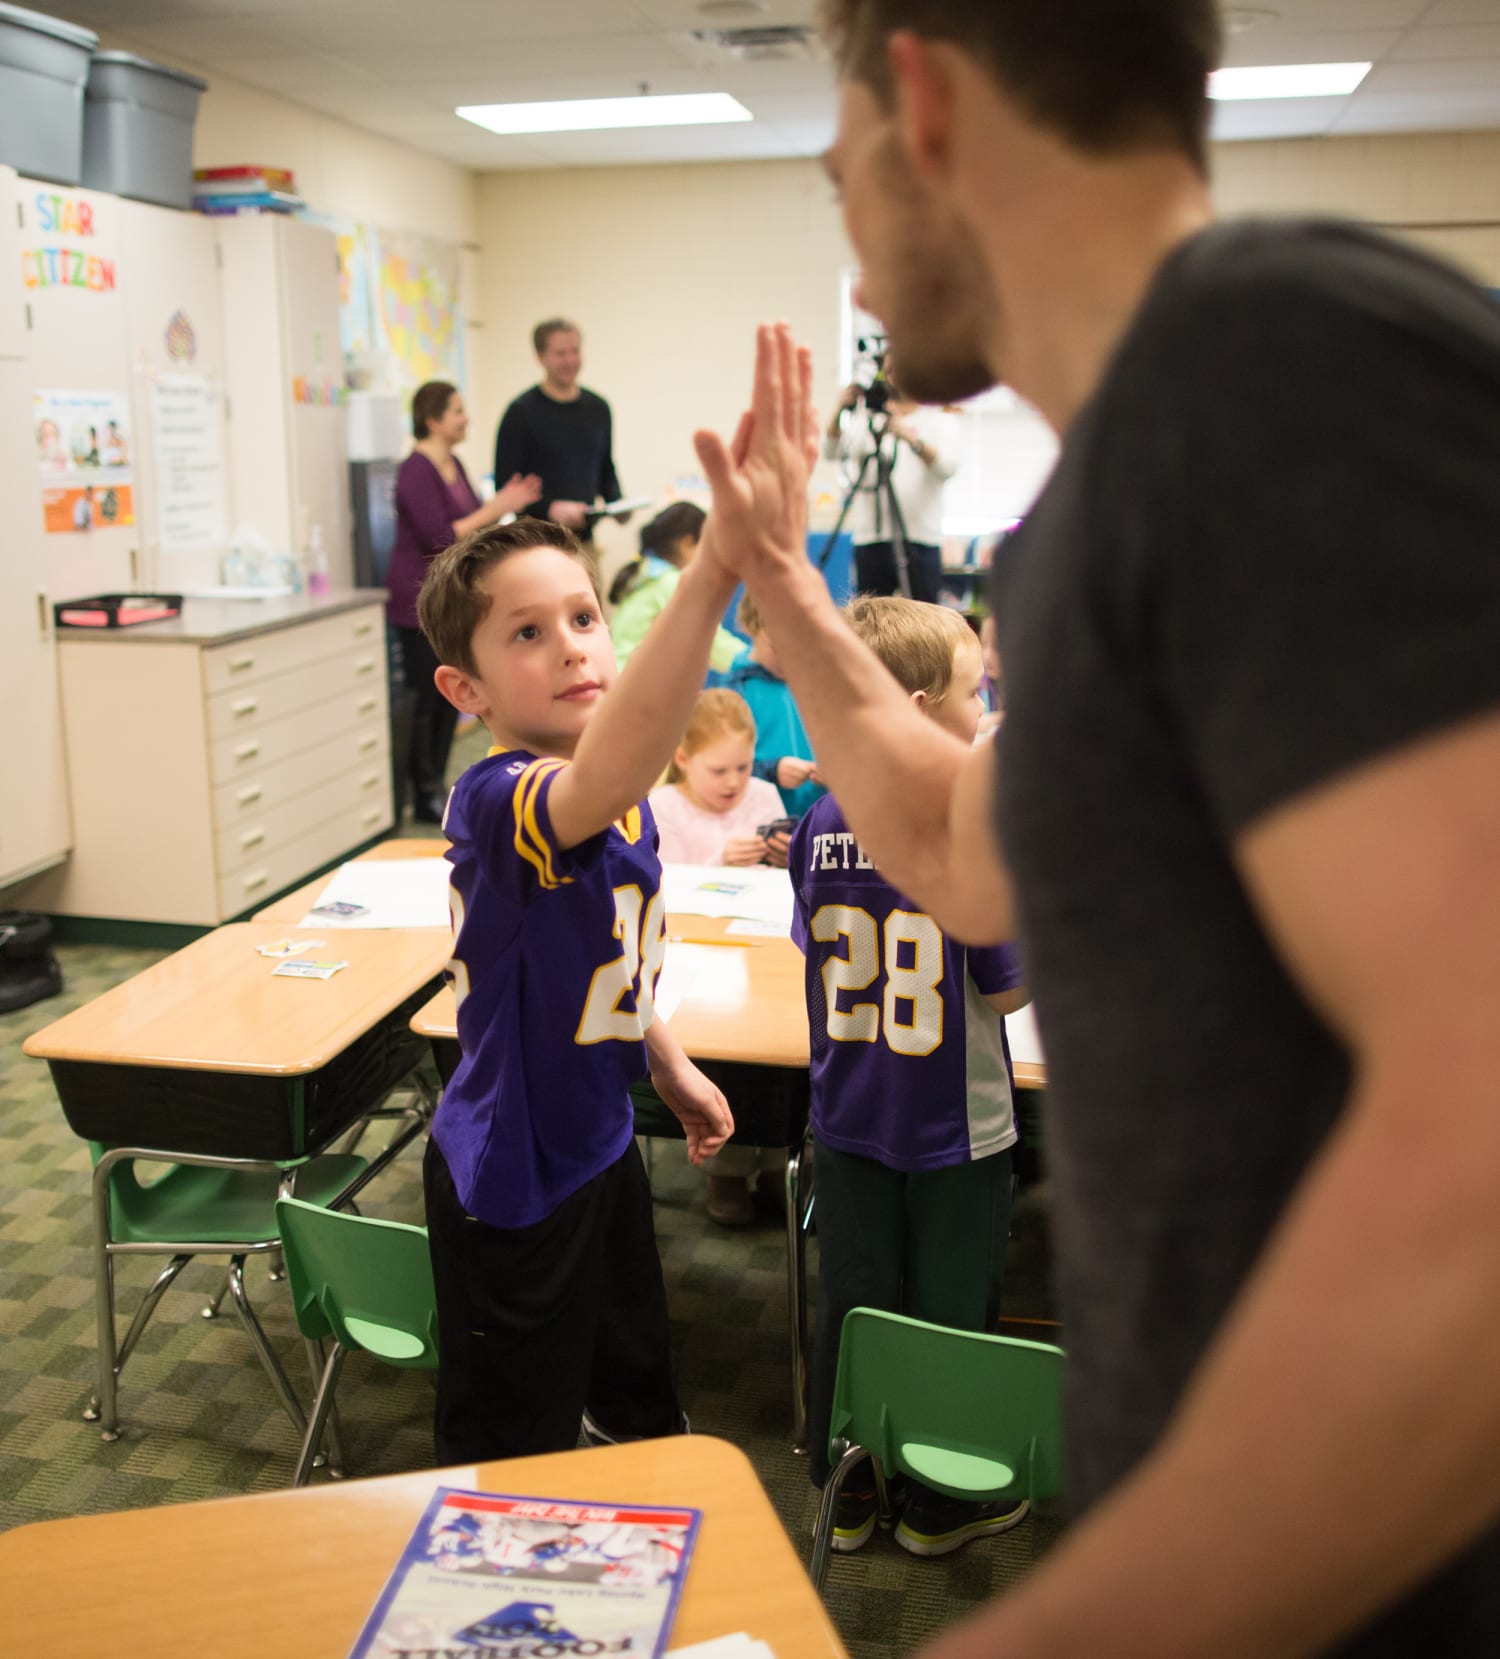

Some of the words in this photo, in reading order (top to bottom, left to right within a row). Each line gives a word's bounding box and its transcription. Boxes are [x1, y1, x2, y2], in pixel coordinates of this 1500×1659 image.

[36, 194, 94, 236] STAR
[22, 248, 115, 292] CITIZEN
[810, 832, 880, 872] PETE
[810, 904, 944, 1057] 28
